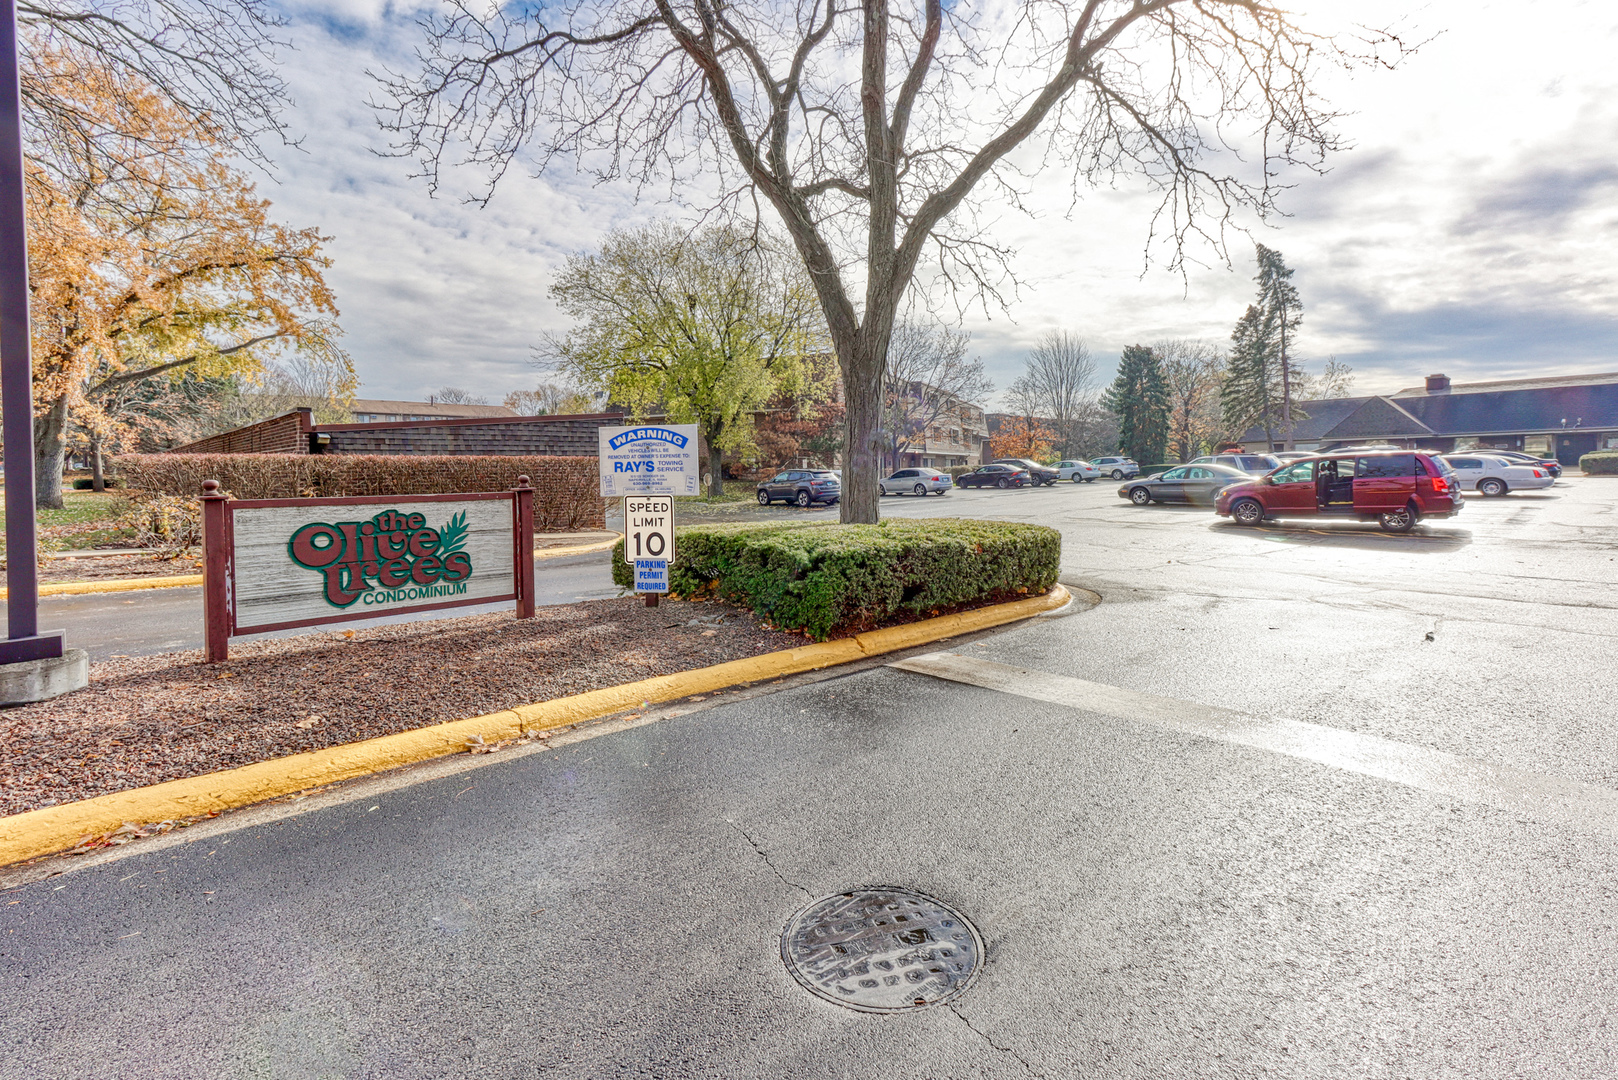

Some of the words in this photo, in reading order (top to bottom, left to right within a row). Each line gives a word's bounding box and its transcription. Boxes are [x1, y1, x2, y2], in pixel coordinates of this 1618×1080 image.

[613, 429, 683, 446] WARNING
[614, 461, 654, 472] RAY'S
[629, 503, 669, 512] SPEED
[376, 511, 425, 532] the
[633, 517, 664, 527] LIMIT
[290, 522, 441, 567] Olive
[633, 532, 665, 556] 10
[636, 560, 665, 568] PARKING
[324, 552, 471, 606] trees
[639, 571, 663, 579] PERMIT
[637, 582, 666, 590] REQUIRED
[363, 583, 467, 605] CONDOMINIUM
